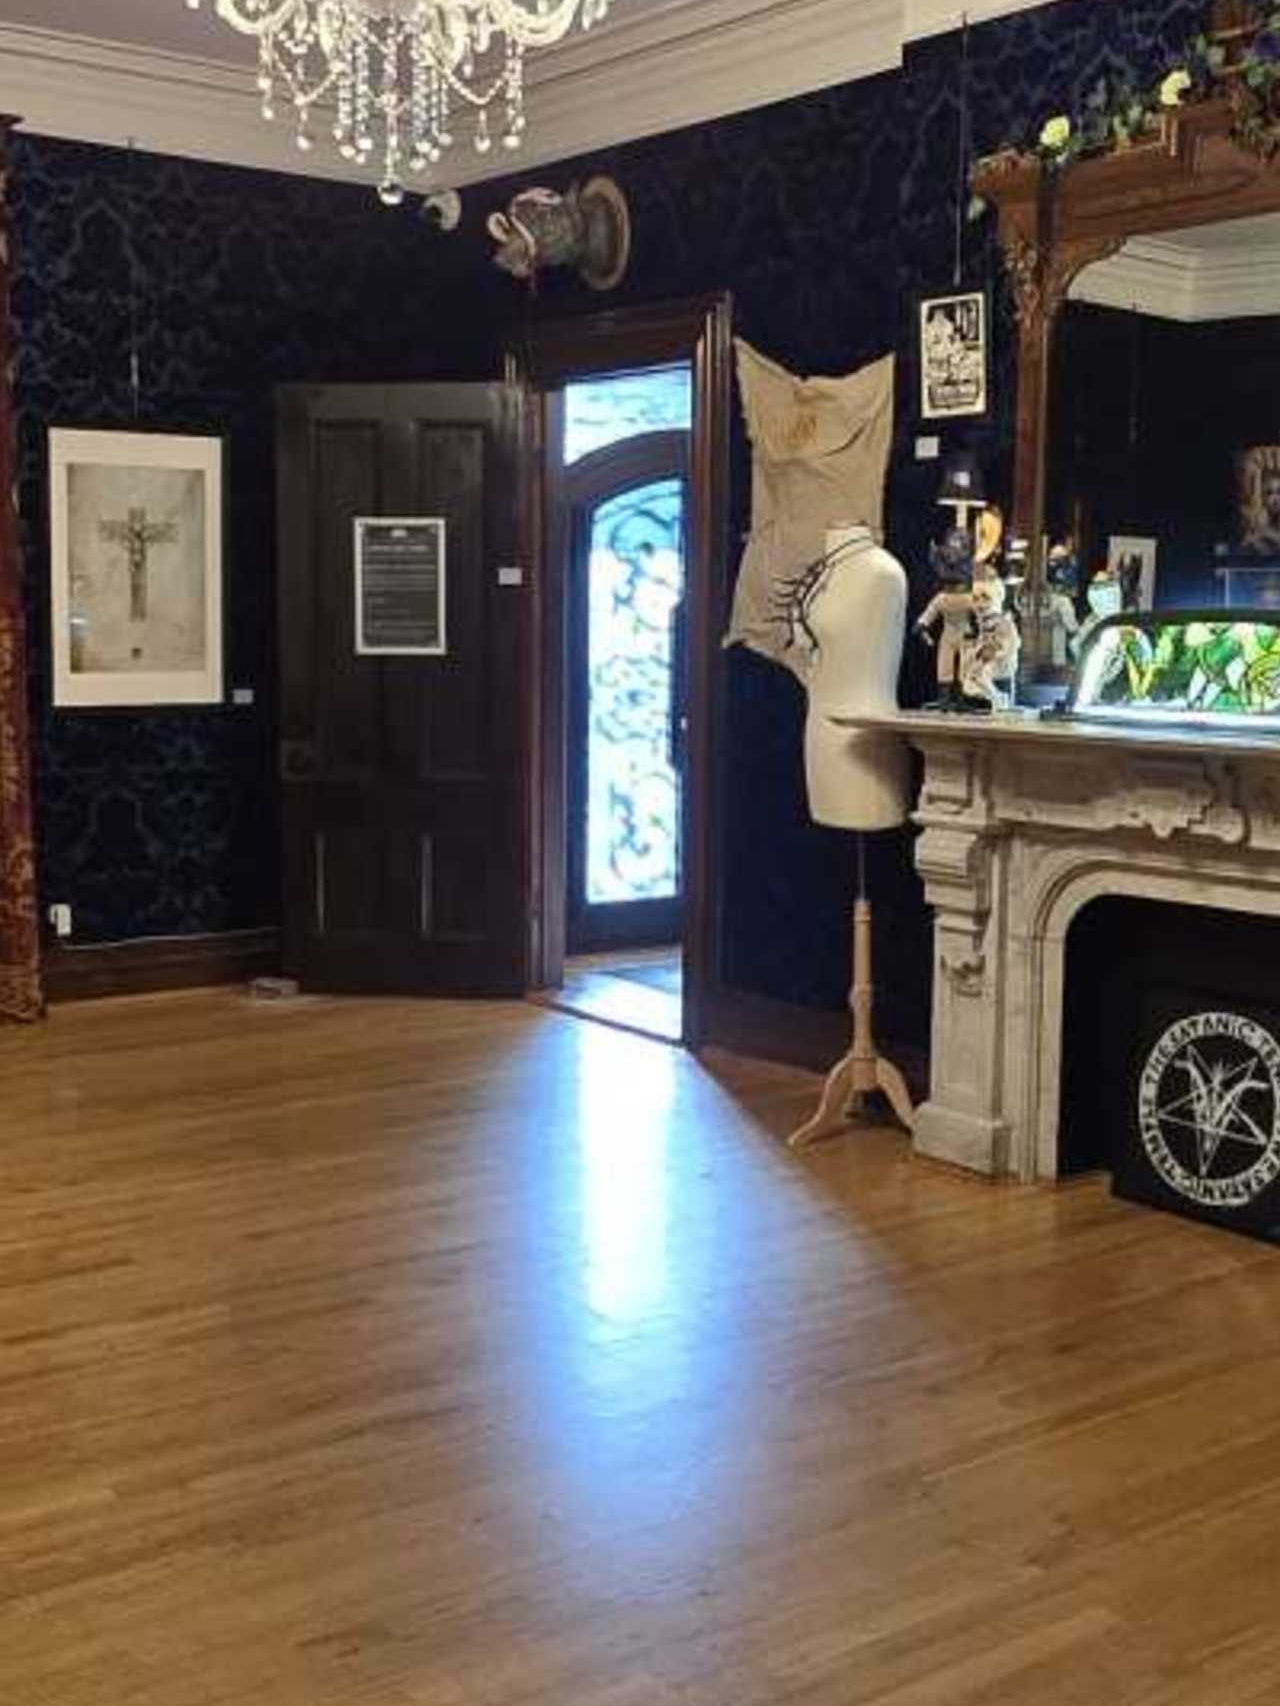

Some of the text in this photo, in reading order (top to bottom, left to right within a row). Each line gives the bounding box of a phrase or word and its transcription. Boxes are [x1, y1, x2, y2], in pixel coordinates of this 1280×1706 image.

[1144, 1047, 1172, 1084] THE
[1170, 1015, 1256, 1043] SATANIC
[1183, 1170, 1265, 1199] SATANIC
